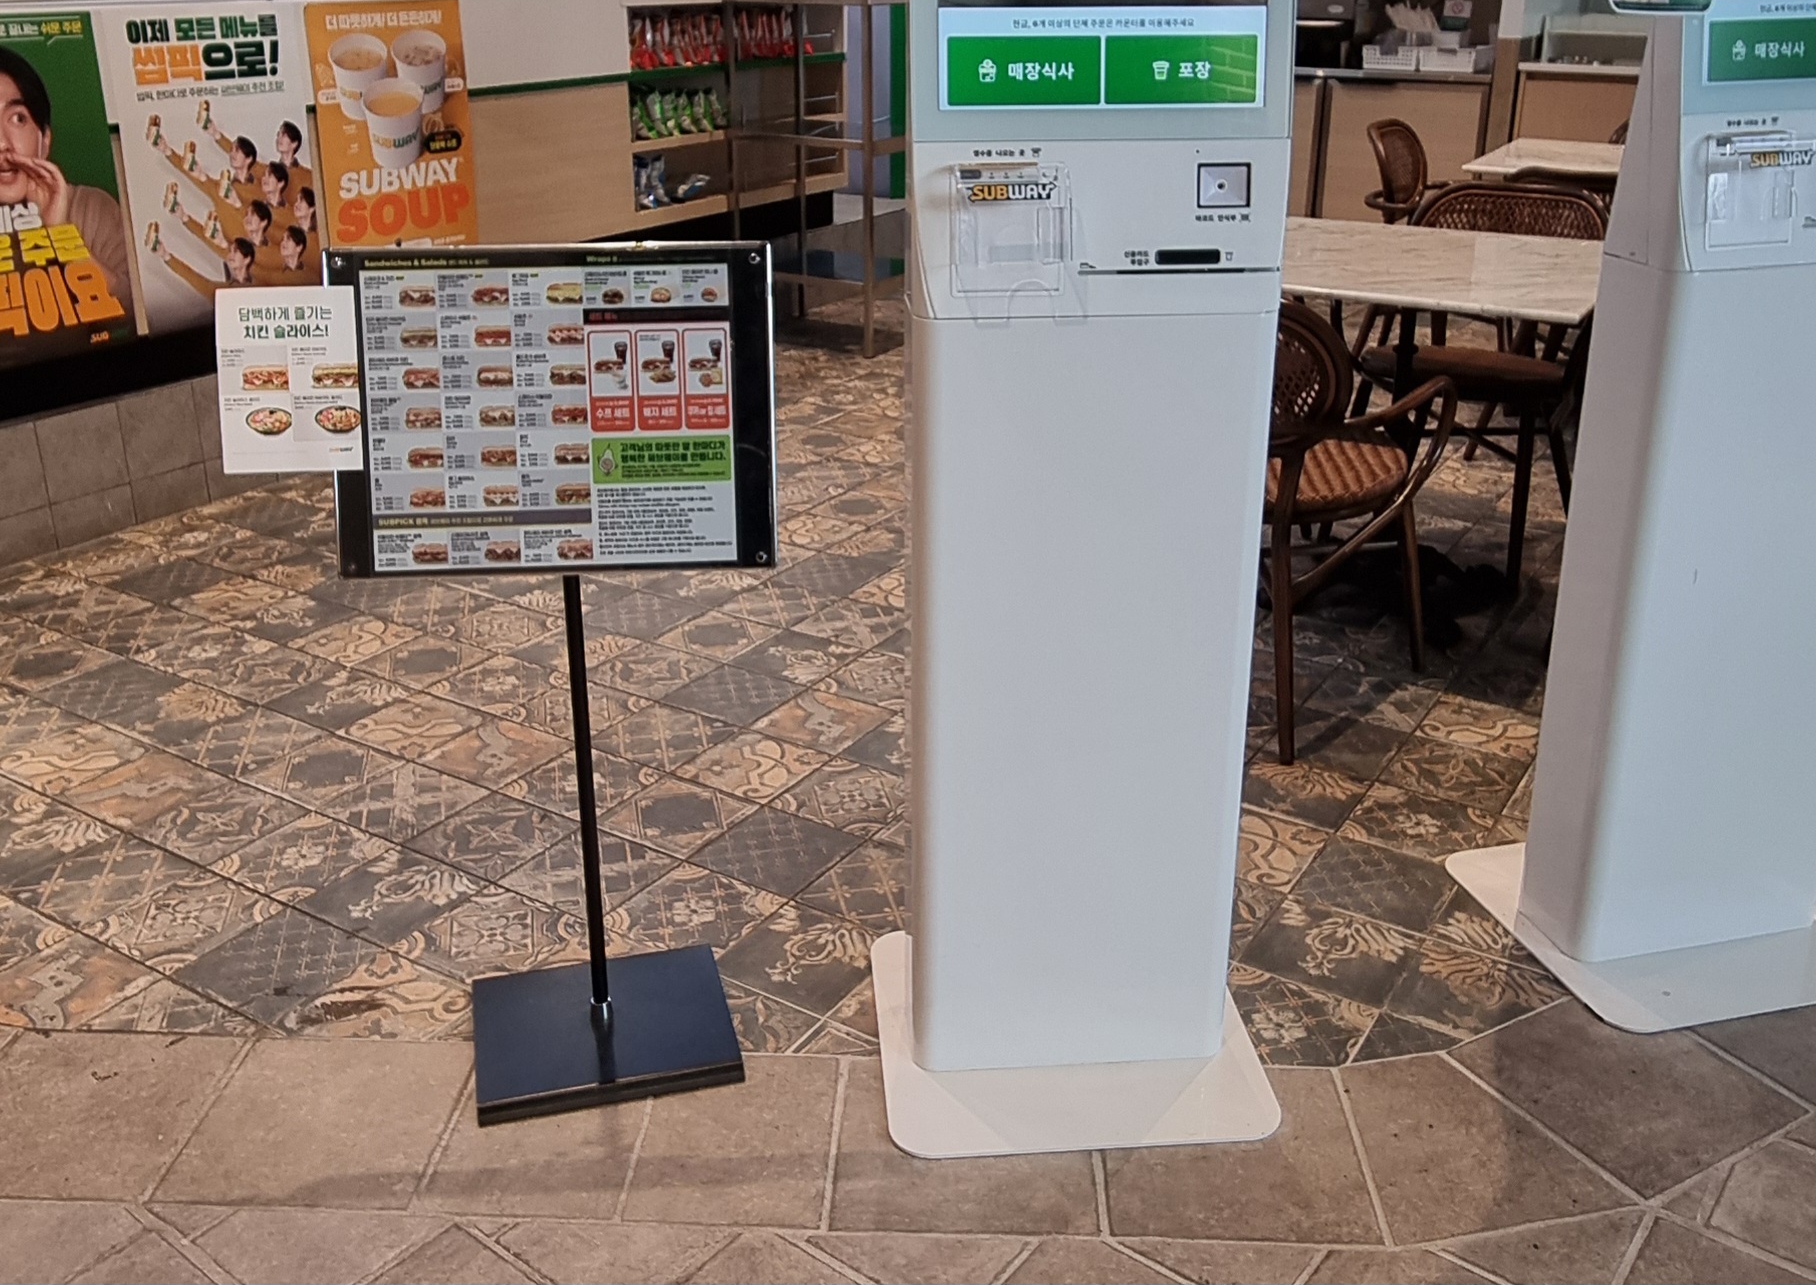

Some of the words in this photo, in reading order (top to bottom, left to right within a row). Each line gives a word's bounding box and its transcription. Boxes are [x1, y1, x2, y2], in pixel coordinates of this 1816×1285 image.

[62, 20, 82, 34] 주문
[125, 18, 170, 44] 이제
[174, 16, 216, 42] 모든
[219, 14, 278, 39] 메뉴를
[1754, 41, 1806, 59] 매장식사
[133, 40, 279, 86] 썹픽으로!
[1007, 61, 1075, 81] 매장식사
[1178, 60, 1211, 80] 포장
[1751, 151, 1813, 167] SUBWAY
[340, 158, 460, 200] SUBWAY
[970, 182, 1055, 202] SUBWAY
[336, 183, 470, 244] SOUP
[18, 224, 90, 267] 주문
[238, 307, 290, 322] 담백하게
[294, 306, 332, 321] 즐기는
[244, 325, 269, 340] 치킨
[274, 324, 329, 340] 슬라이스!
